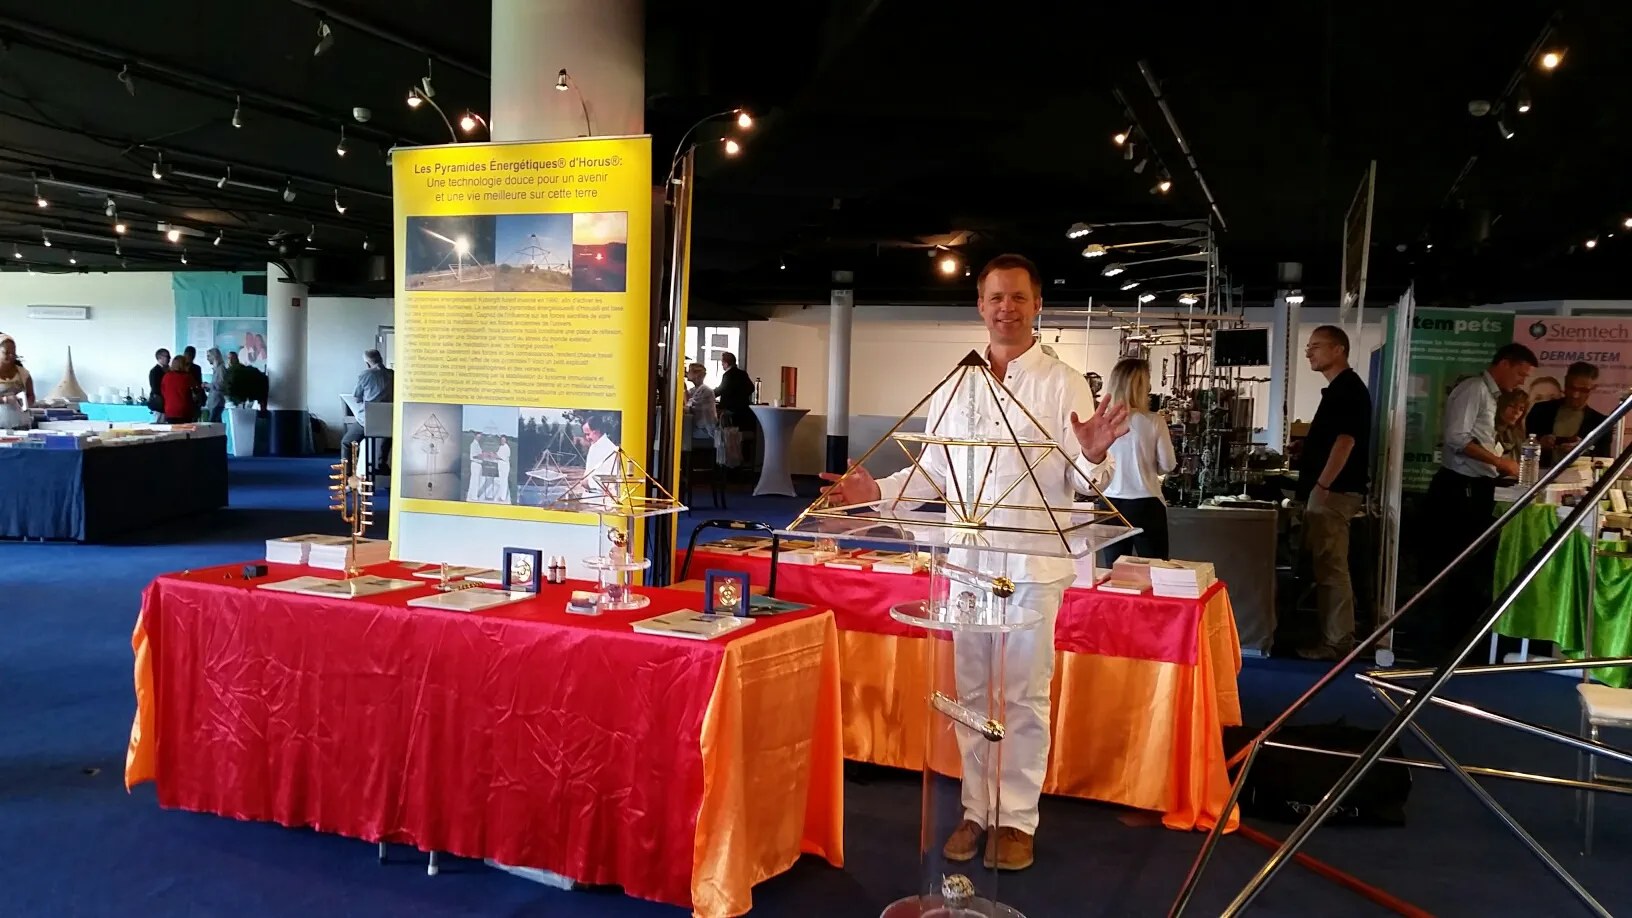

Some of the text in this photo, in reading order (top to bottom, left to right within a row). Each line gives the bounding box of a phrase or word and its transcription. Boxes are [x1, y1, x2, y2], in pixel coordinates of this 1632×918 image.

[414, 156, 623, 176] Les Pyramides Énergétiques® d'Horus®:
[427, 172, 608, 188] Une technologie douce pour un avenir
[435, 189, 598, 202] et une vie meilleure sur cette terre
[1408, 315, 1503, 334] tempets
[1550, 324, 1628, 338] Stemtech
[1540, 350, 1620, 362] DERMASTEM
